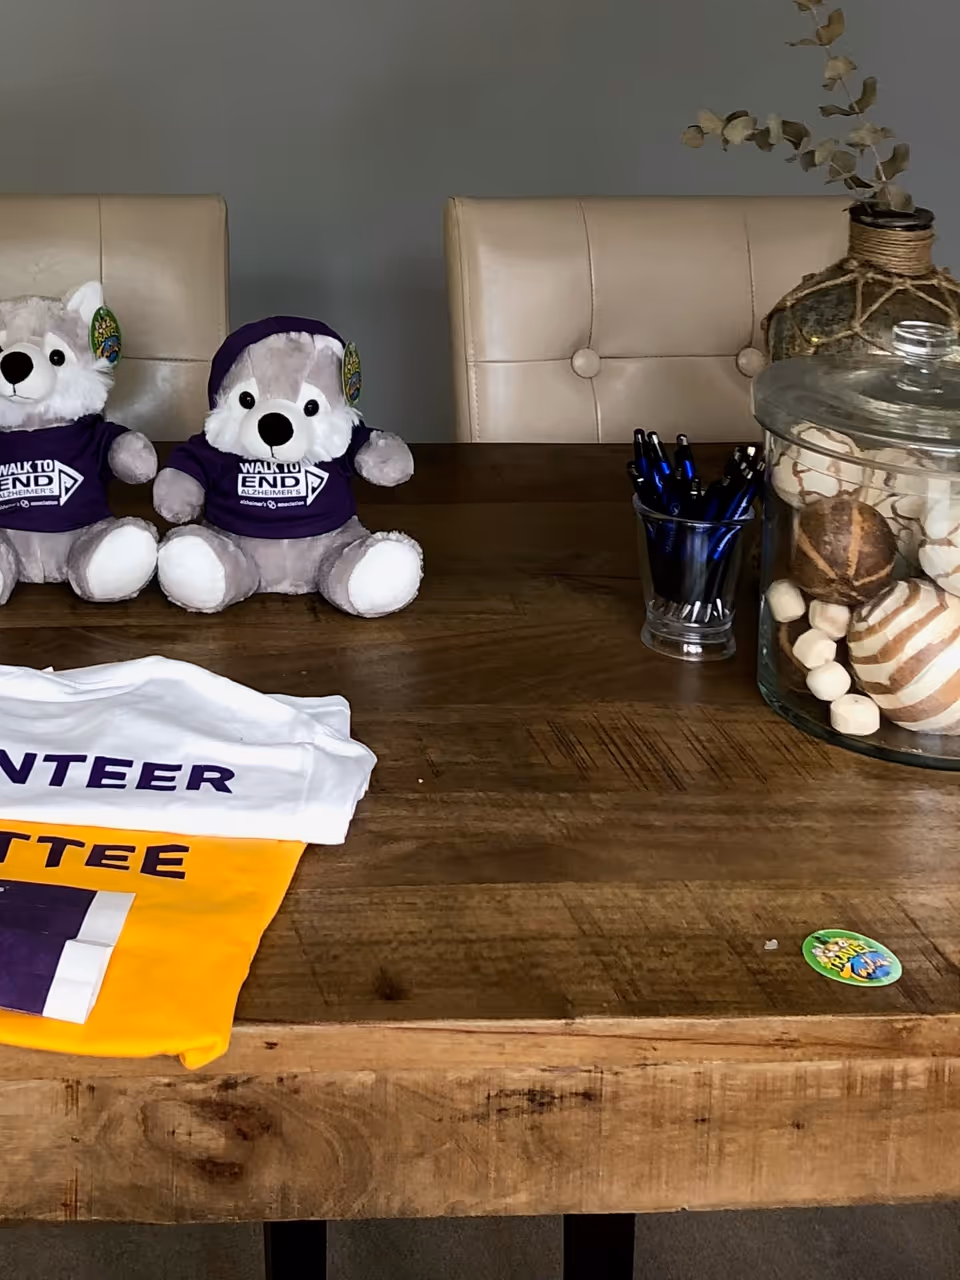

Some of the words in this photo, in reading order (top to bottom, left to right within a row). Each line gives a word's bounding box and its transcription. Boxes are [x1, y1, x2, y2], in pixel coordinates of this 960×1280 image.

[34, 459, 54, 473] TO
[238, 461, 280, 474] WALK
[240, 475, 301, 489] END
[240, 488, 302, 496] ALZHEIMER'S
